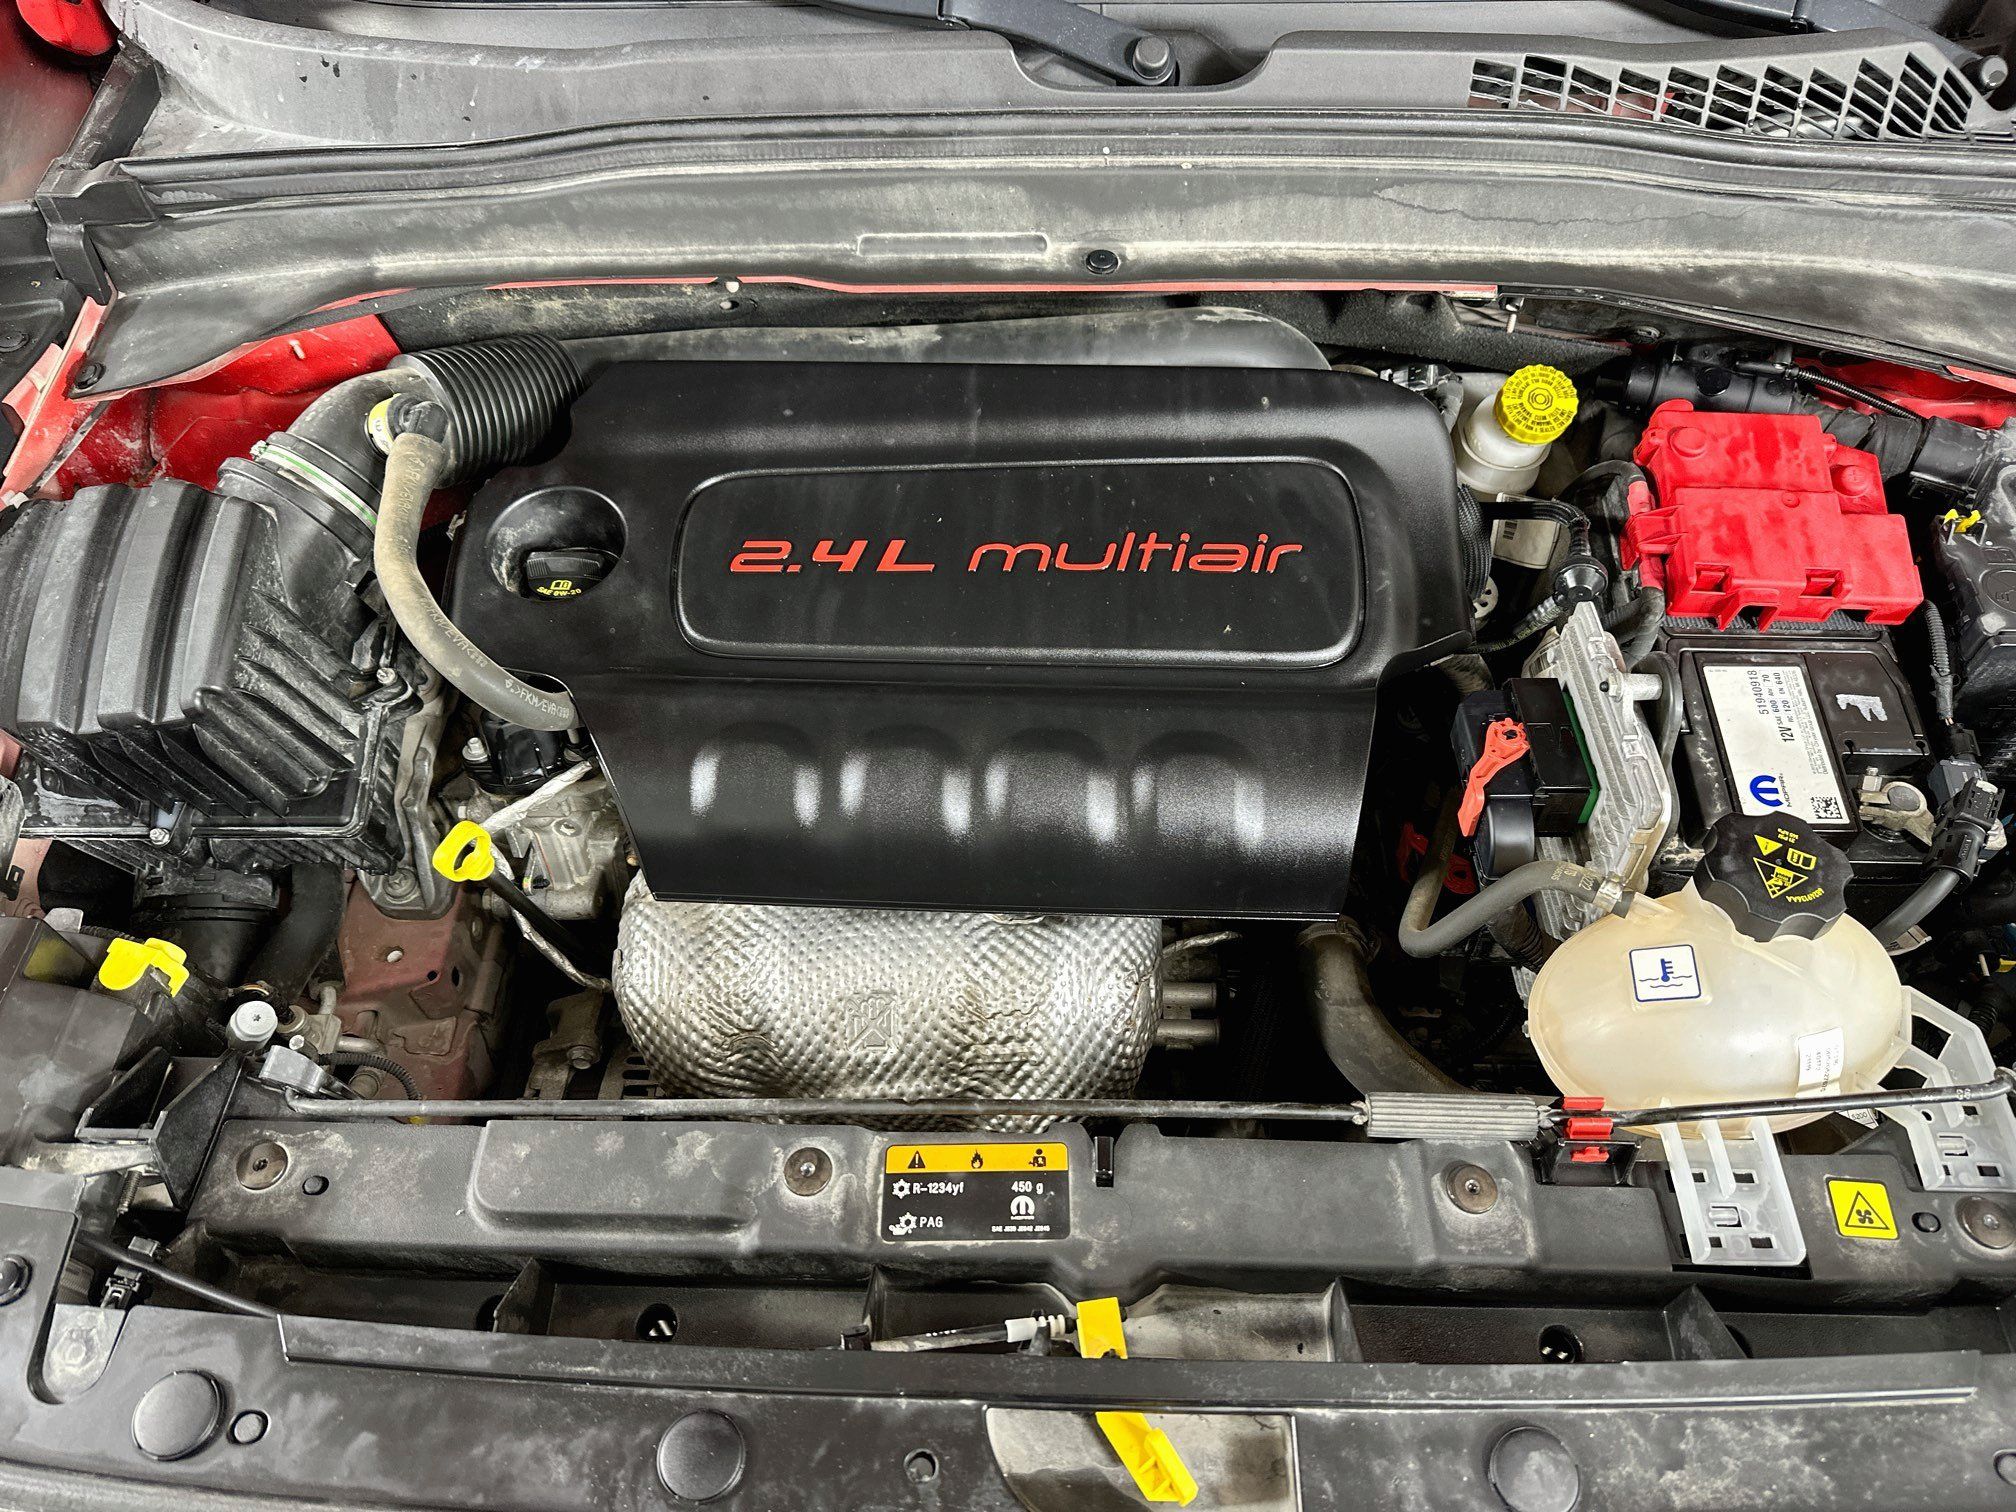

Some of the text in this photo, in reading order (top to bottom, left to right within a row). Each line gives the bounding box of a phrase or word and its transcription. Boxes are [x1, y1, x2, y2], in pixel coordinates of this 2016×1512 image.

[967, 532, 1303, 574] multiair
[537, 586, 582, 597] SAE 0W-20
[1761, 674, 1770, 682] 70
[1772, 672, 1783, 684] 640
[1746, 670, 1769, 714] 51940918
[1769, 699, 1780, 712] 600
[1781, 699, 1791, 711] 120
[1778, 726, 1795, 741] 12V
[1777, 775, 1792, 807] MOPAR
[912, 1181, 1044, 1196] R-1234yf 450 g
[919, 1216, 943, 1228] PAG
